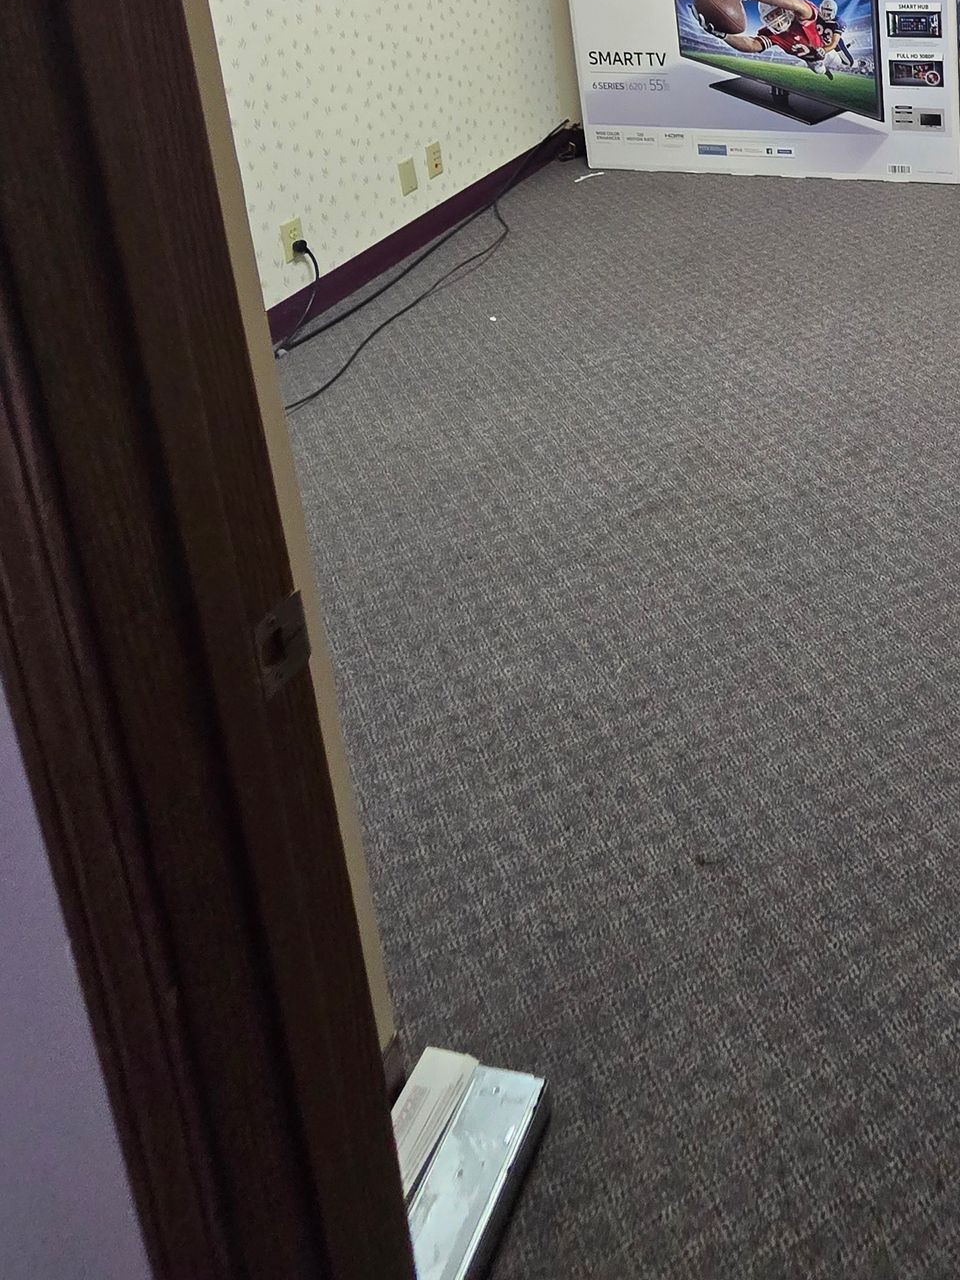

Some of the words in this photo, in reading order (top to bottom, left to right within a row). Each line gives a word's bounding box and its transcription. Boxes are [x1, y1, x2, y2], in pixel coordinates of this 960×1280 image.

[588, 50, 643, 66] SMART
[645, 52, 666, 67] TV
[592, 81, 598, 90] 6
[598, 81, 625, 91] SERIES
[628, 82, 647, 91] 6201
